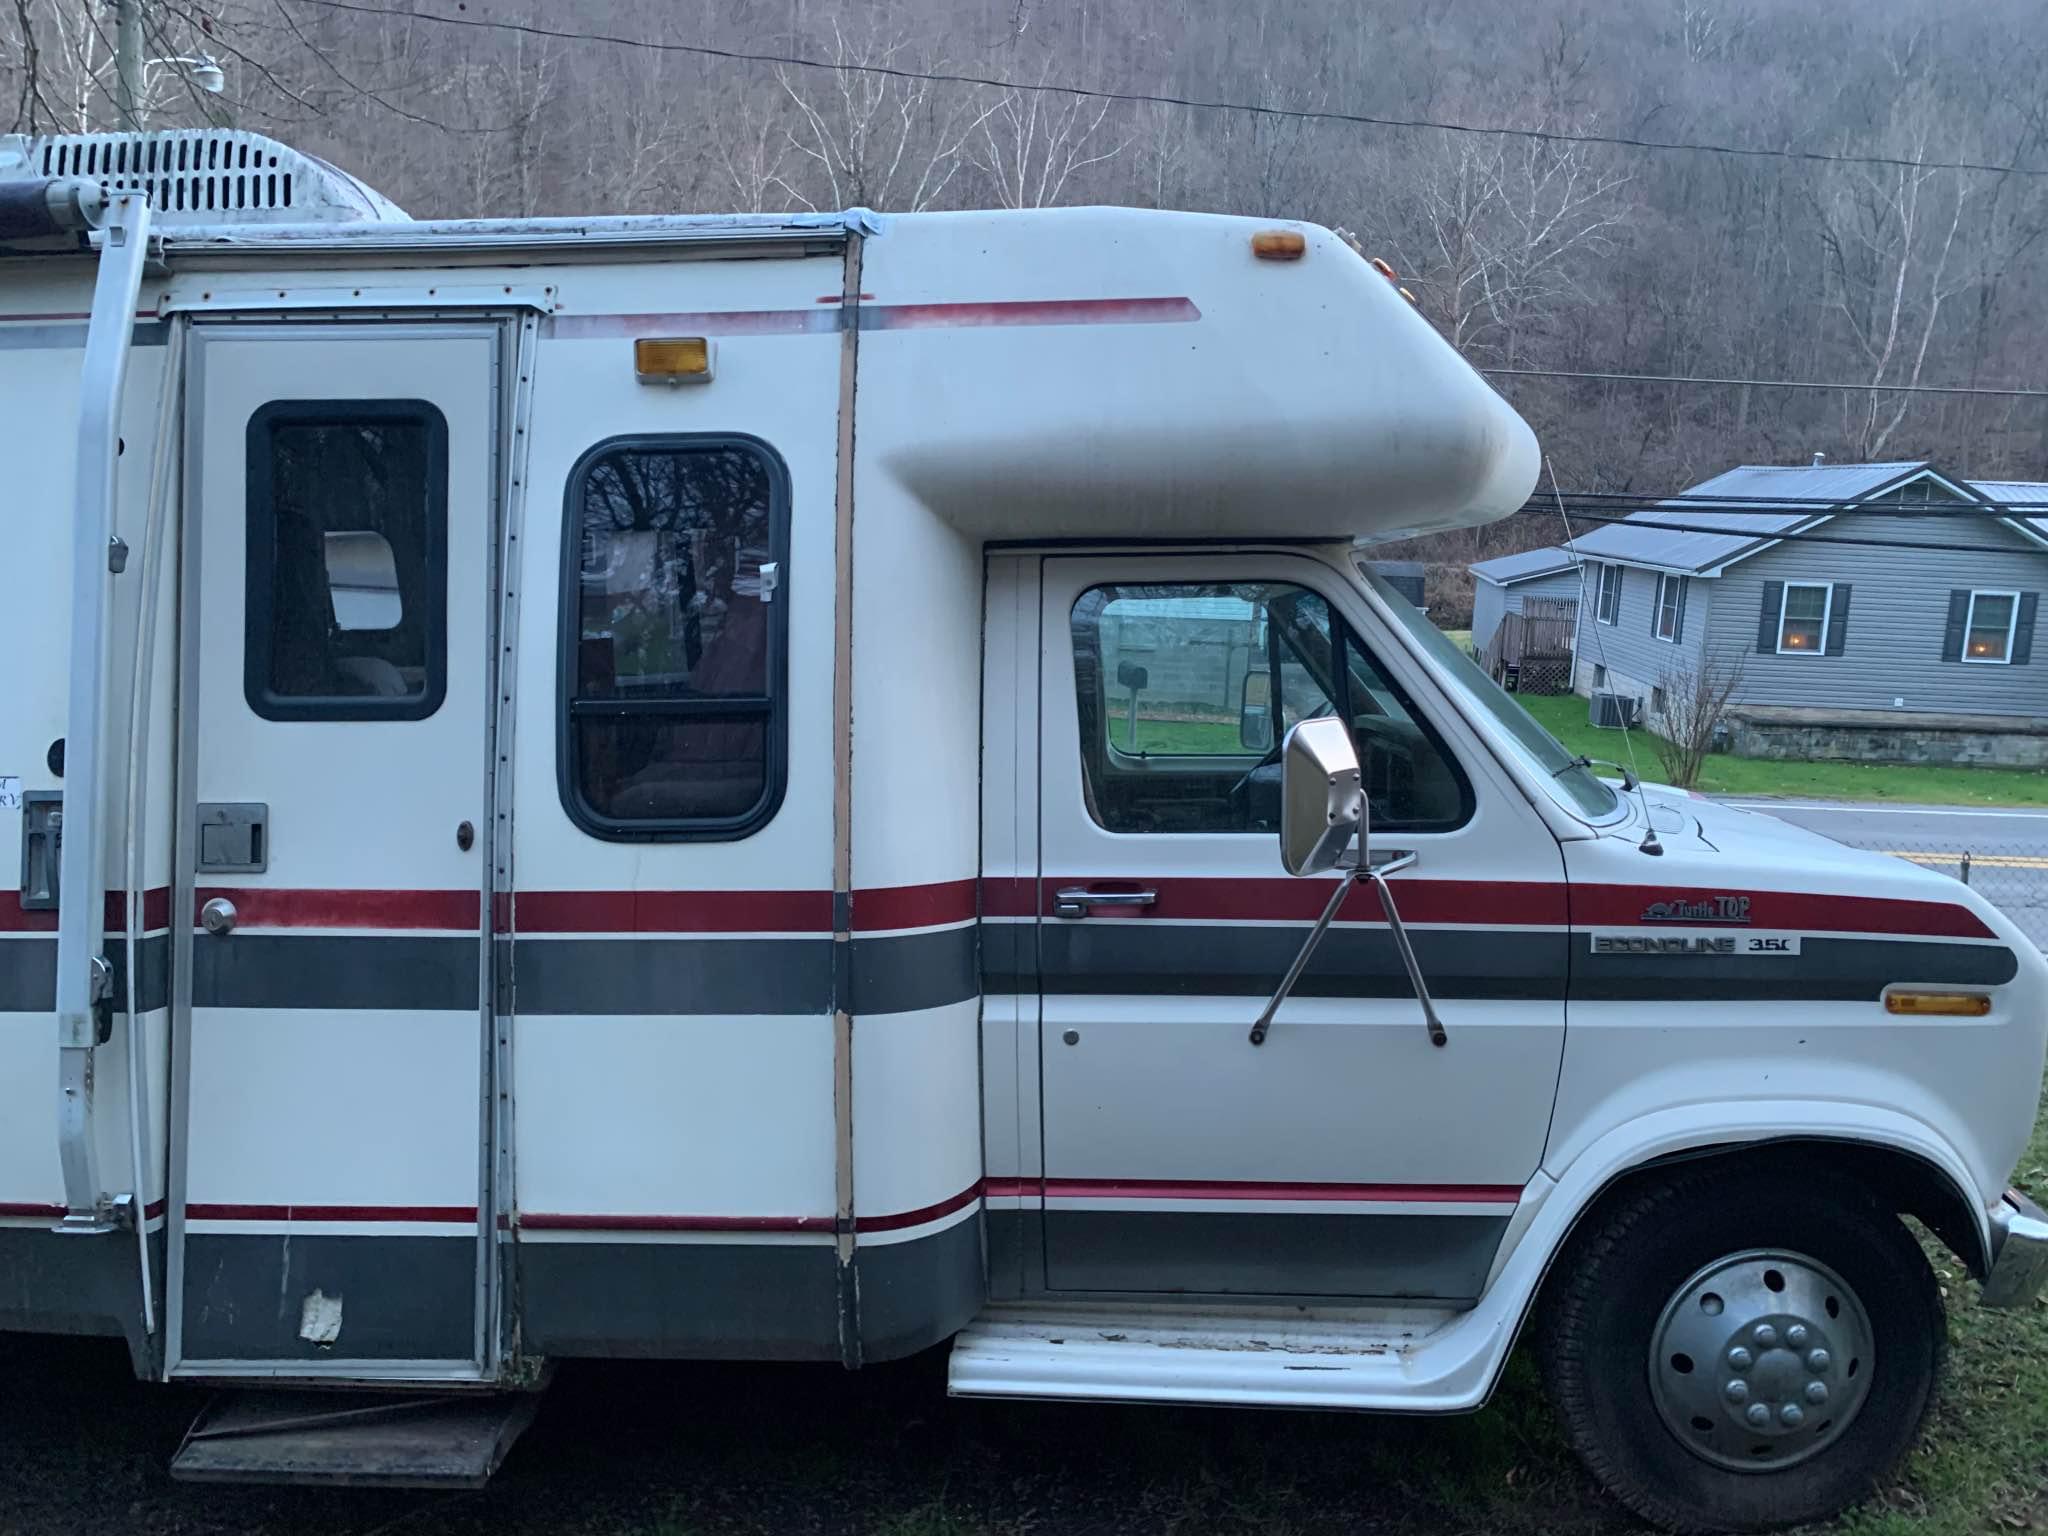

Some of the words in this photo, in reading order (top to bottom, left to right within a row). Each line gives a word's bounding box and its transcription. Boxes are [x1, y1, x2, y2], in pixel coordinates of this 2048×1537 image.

[1673, 899, 1714, 919] Turtle
[1714, 896, 1751, 919] TOP
[1594, 935, 1736, 953] ECONOLINE
